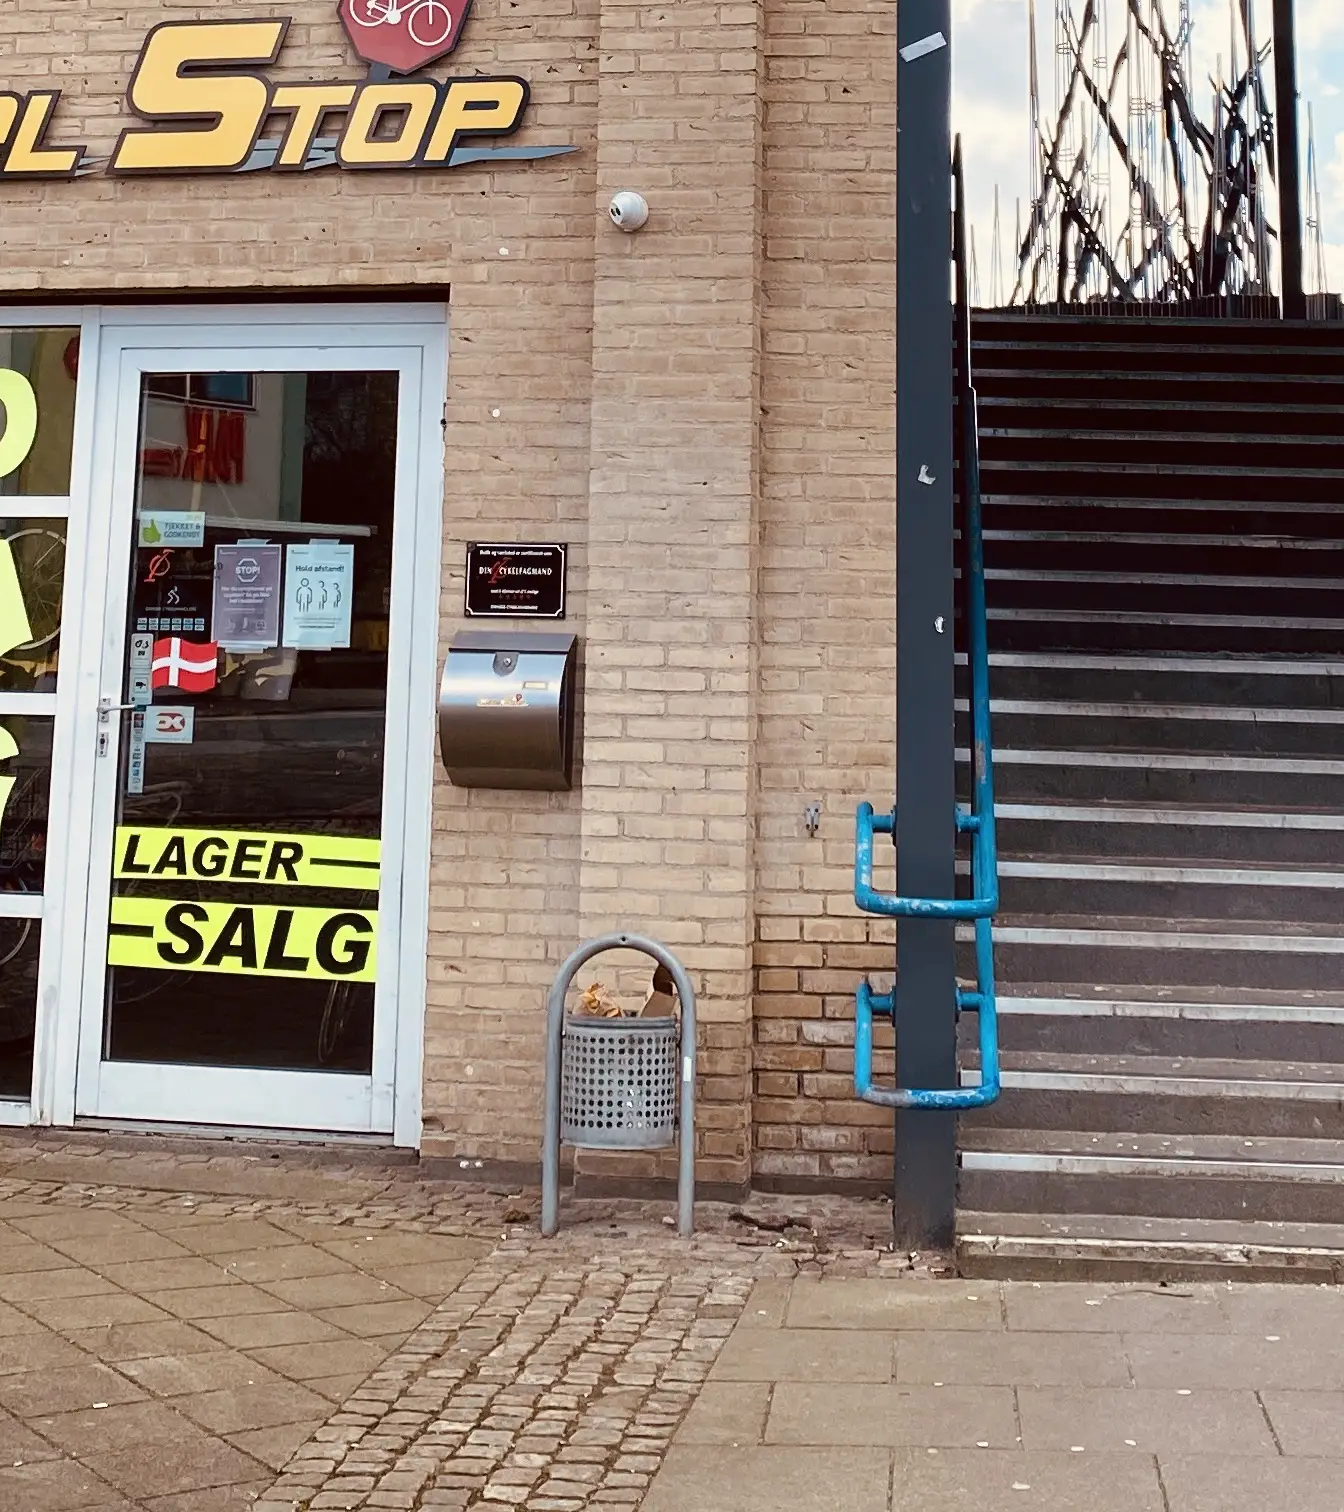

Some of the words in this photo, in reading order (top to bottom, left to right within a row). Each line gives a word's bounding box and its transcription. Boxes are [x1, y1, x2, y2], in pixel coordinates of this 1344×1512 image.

[235, 566, 261, 575] STOP!
[120, 834, 304, 882] LAGER
[156, 902, 375, 975] SALG
